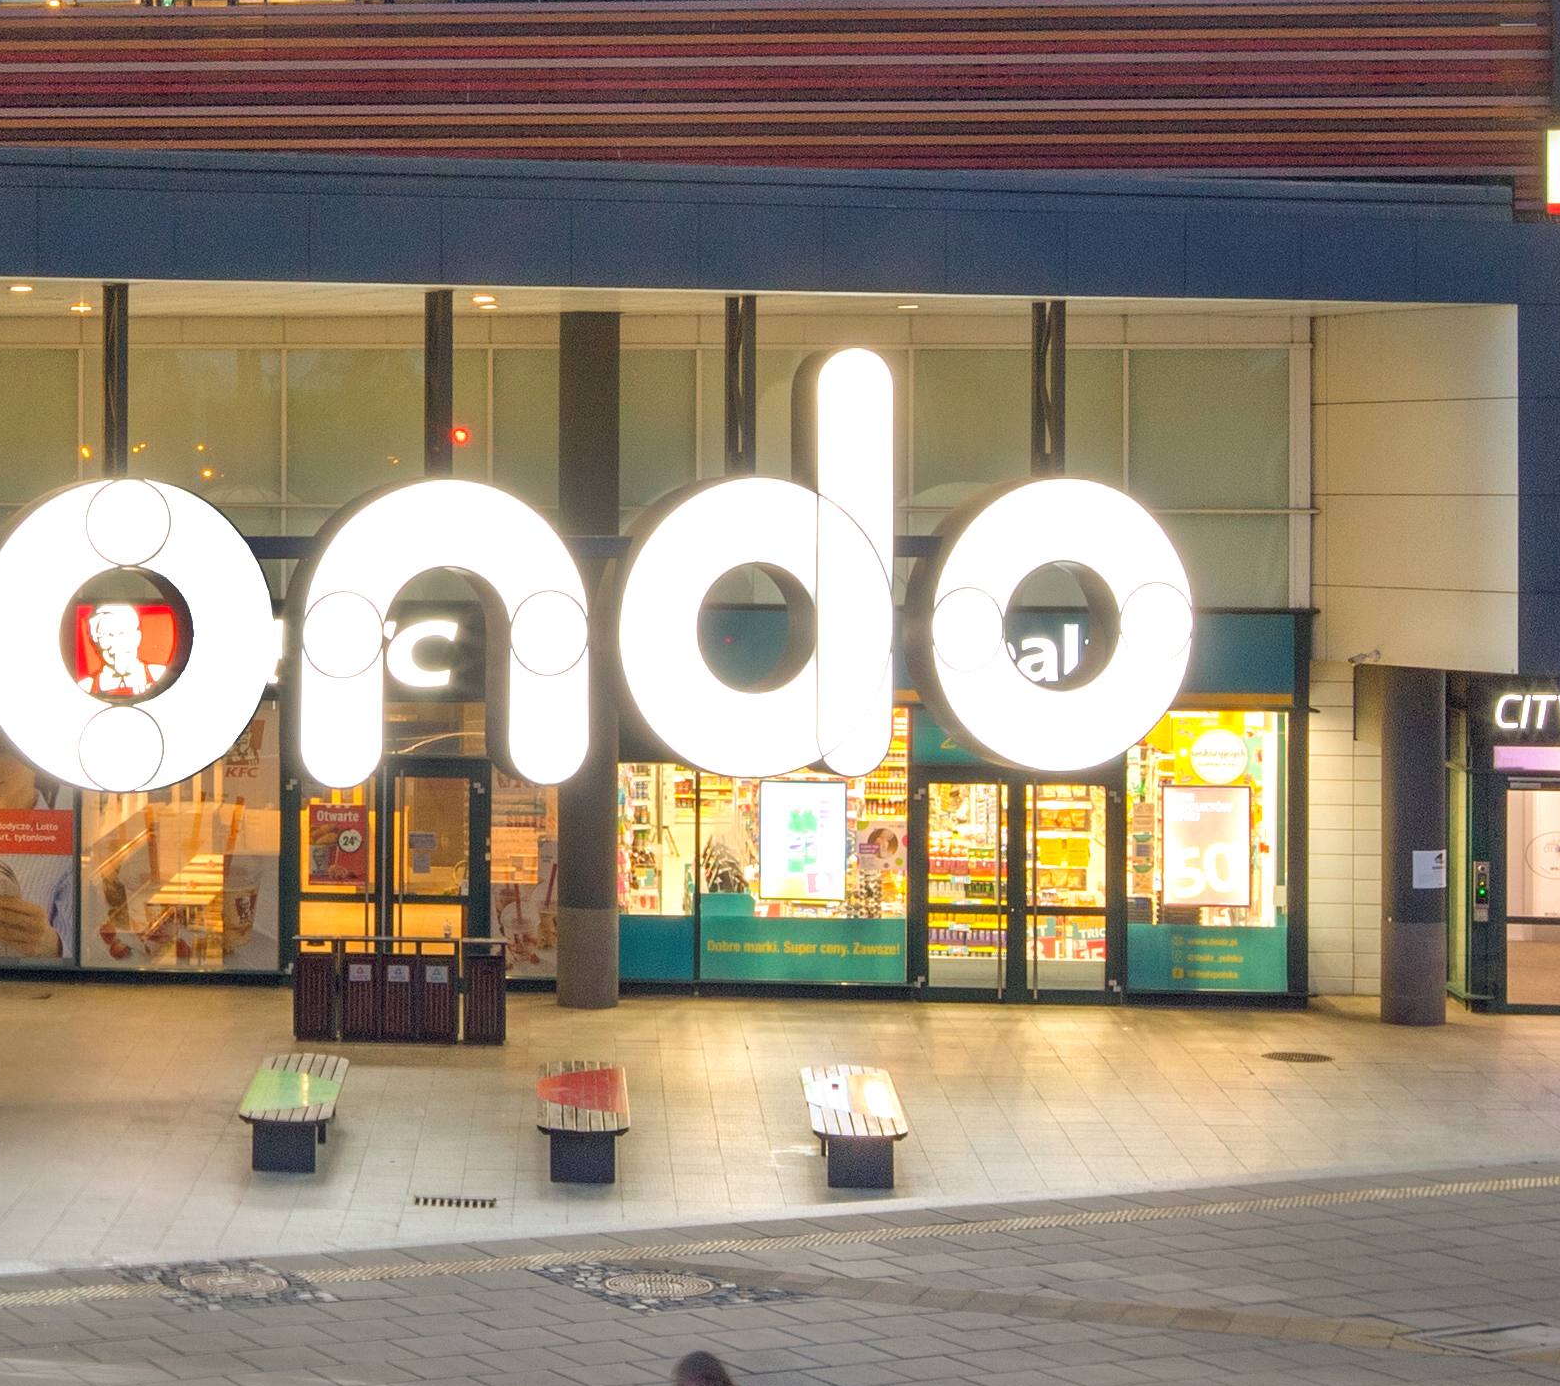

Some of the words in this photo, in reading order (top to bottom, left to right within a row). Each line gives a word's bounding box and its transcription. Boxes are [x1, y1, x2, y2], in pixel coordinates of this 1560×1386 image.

[225, 767, 258, 779] KFC
[316, 810, 360, 822] Otwarte
[35, 822, 59, 831] Lotto
[14, 833, 57, 843] tytoniowe
[707, 939, 740, 951] Dobre
[743, 940, 780, 953] marki.
[783, 941, 816, 955] Super
[819, 943, 849, 956] ceny.
[852, 942, 900, 955] Zawsze!
